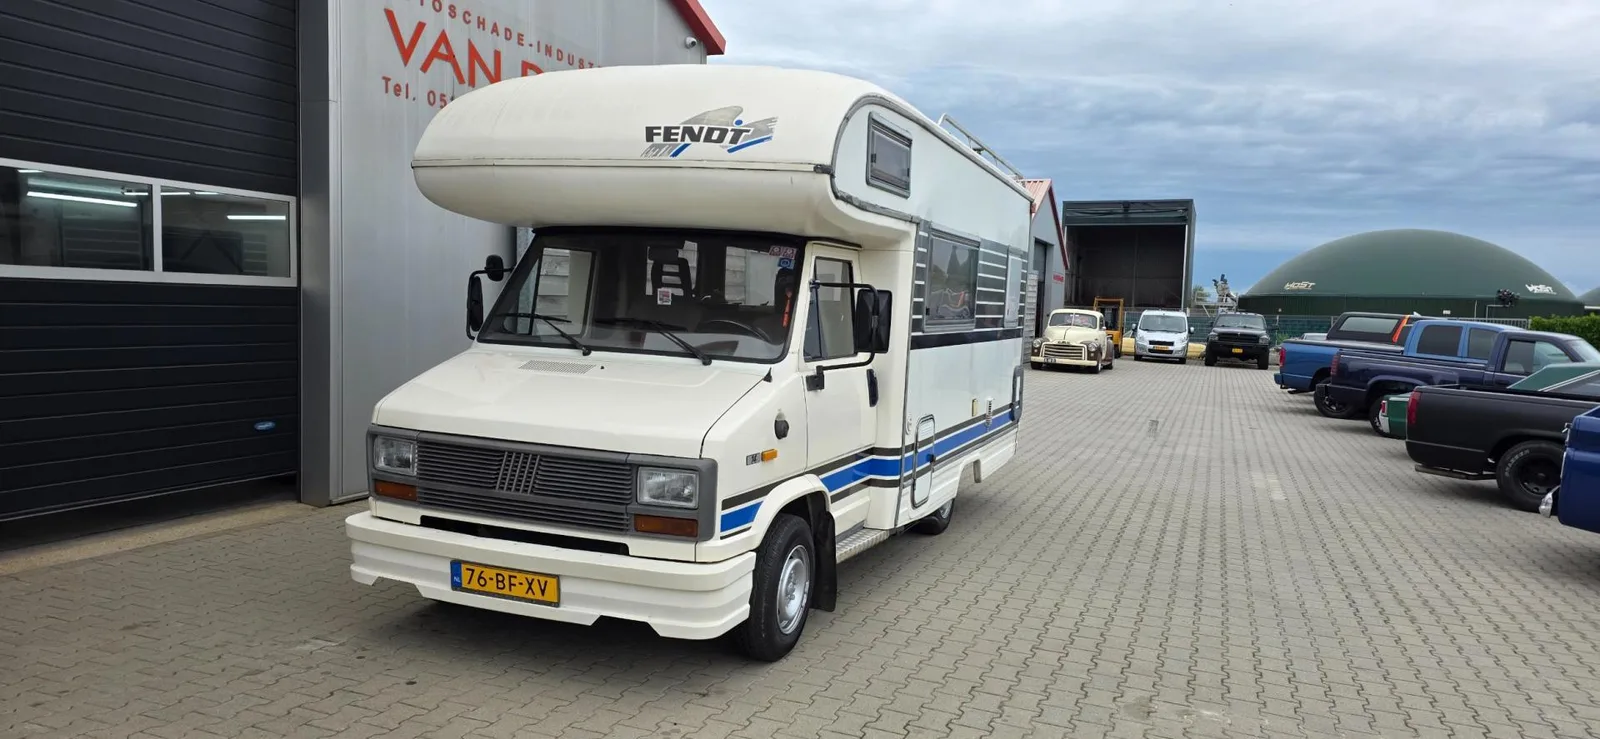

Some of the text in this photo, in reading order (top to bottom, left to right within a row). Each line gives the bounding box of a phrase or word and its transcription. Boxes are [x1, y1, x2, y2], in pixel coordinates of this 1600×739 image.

[384, 8, 501, 88] VAN
[382, 76, 416, 101] Tel.
[645, 125, 751, 145] FENDT
[465, 567, 548, 597] 76-BF-XV
